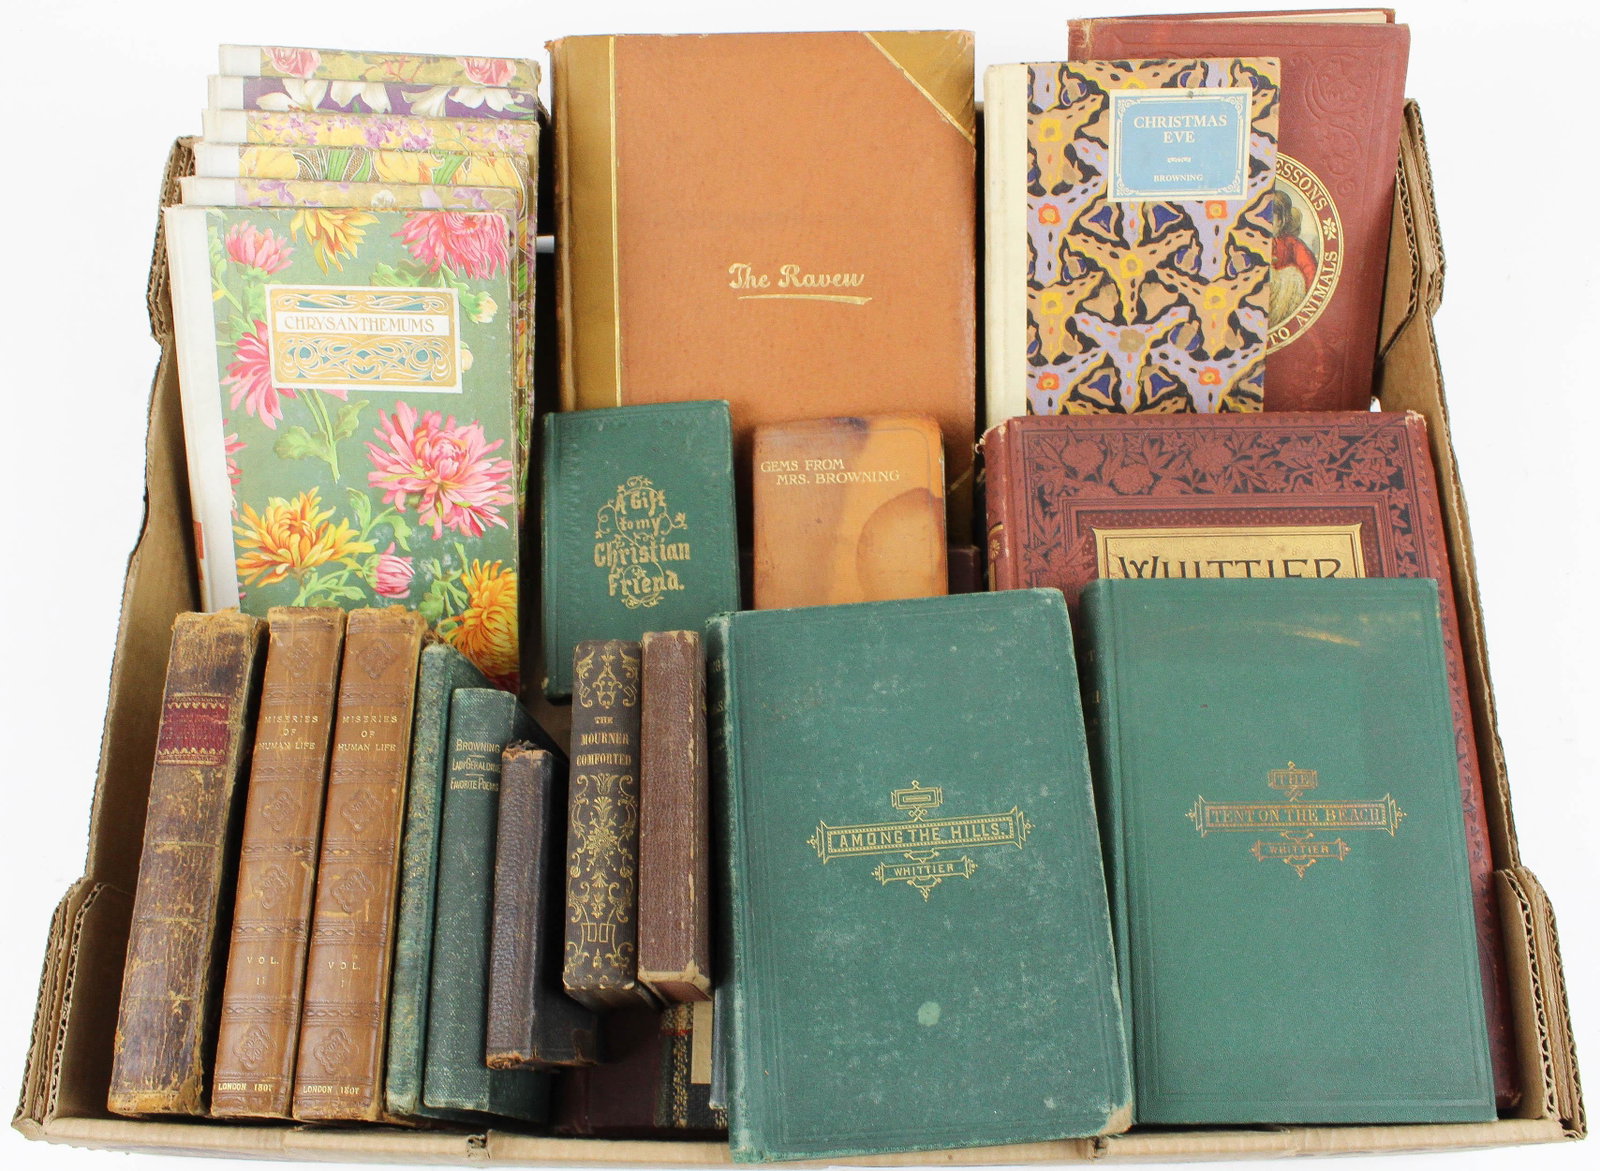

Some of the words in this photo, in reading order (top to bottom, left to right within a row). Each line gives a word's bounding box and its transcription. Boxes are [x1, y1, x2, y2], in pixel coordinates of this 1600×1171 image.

[1133, 114, 1228, 129] CHRISTMAS
[1163, 130, 1195, 143] EVE
[1153, 174, 1203, 182] BROWNING
[1275, 160, 1328, 212] ESSONS
[728, 262, 771, 289] The
[778, 264, 865, 288] Raven
[1269, 326, 1291, 346] TO
[1295, 251, 1338, 327] ANIMALS
[284, 316, 435, 333] CHRYSANTHEMUMS
[760, 460, 799, 473] GEMS
[805, 458, 845, 471] FROM
[776, 473, 811, 486] MRS.
[815, 470, 900, 484] BROWNING
[615, 493, 627, 515] A
[630, 490, 666, 517] Gift
[619, 517, 633, 531] to
[635, 517, 661, 537] my
[594, 538, 691, 572] Christian
[264, 715, 319, 724] MISERIES
[342, 714, 398, 724] MISERIES
[594, 716, 614, 725] THE
[283, 728, 297, 737] OF
[361, 730, 376, 738] OF
[580, 732, 630, 746] MOURNER
[295, 742, 316, 750] LIFE
[338, 743, 370, 752] HUMAN
[376, 743, 397, 752] LIFE
[456, 738, 501, 753] BROWNING
[576, 754, 632, 767] COMFORTED
[1276, 773, 1310, 786] THE
[1211, 809, 1255, 823] TENT
[1258, 808, 1280, 822] ON
[1284, 809, 1318, 822] THE
[1325, 809, 1381, 822] BEACH
[839, 830, 903, 848] AMONG
[908, 827, 940, 843] THE
[951, 823, 1005, 839] HILLS.
[1268, 844, 1329, 854] WHITTIER
[893, 864, 954, 876] WHITTIER
[218, 1082, 247, 1092] LONDON
[303, 1085, 333, 1094] LONDON
